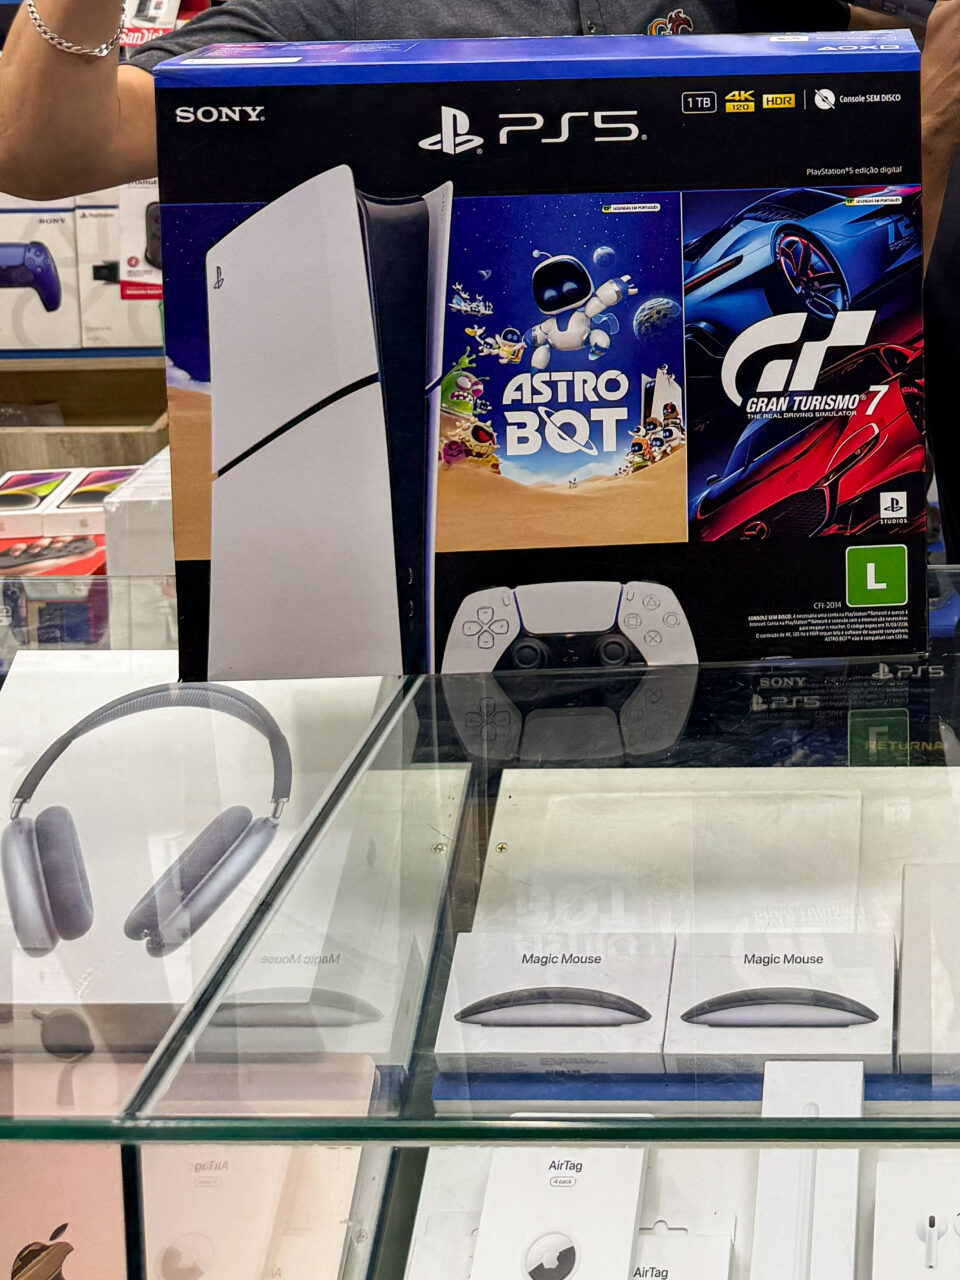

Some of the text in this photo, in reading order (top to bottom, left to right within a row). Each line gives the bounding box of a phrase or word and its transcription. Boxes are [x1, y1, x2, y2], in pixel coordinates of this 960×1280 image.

[724, 90, 756, 101] 4K
[766, 96, 792, 106] HDR
[839, 94, 901, 103] Console SEM DISCO
[696, 98, 711, 108] TB
[175, 106, 266, 124] SONY
[498, 110, 641, 144] PS5
[855, 166, 879, 175] edição
[880, 166, 903, 176] digital
[502, 370, 629, 406] ASTRO
[746, 384, 890, 416] GRAN TURISMO 7
[505, 407, 629, 456] BOT
[866, 562, 888, 591] L
[759, 677, 806, 688] SONY
[521, 953, 602, 967] Magic Mouse
[743, 953, 824, 967] Magic Mouse
[548, 1159, 583, 1174] AirTag
[633, 1266, 669, 1280] AirTag
